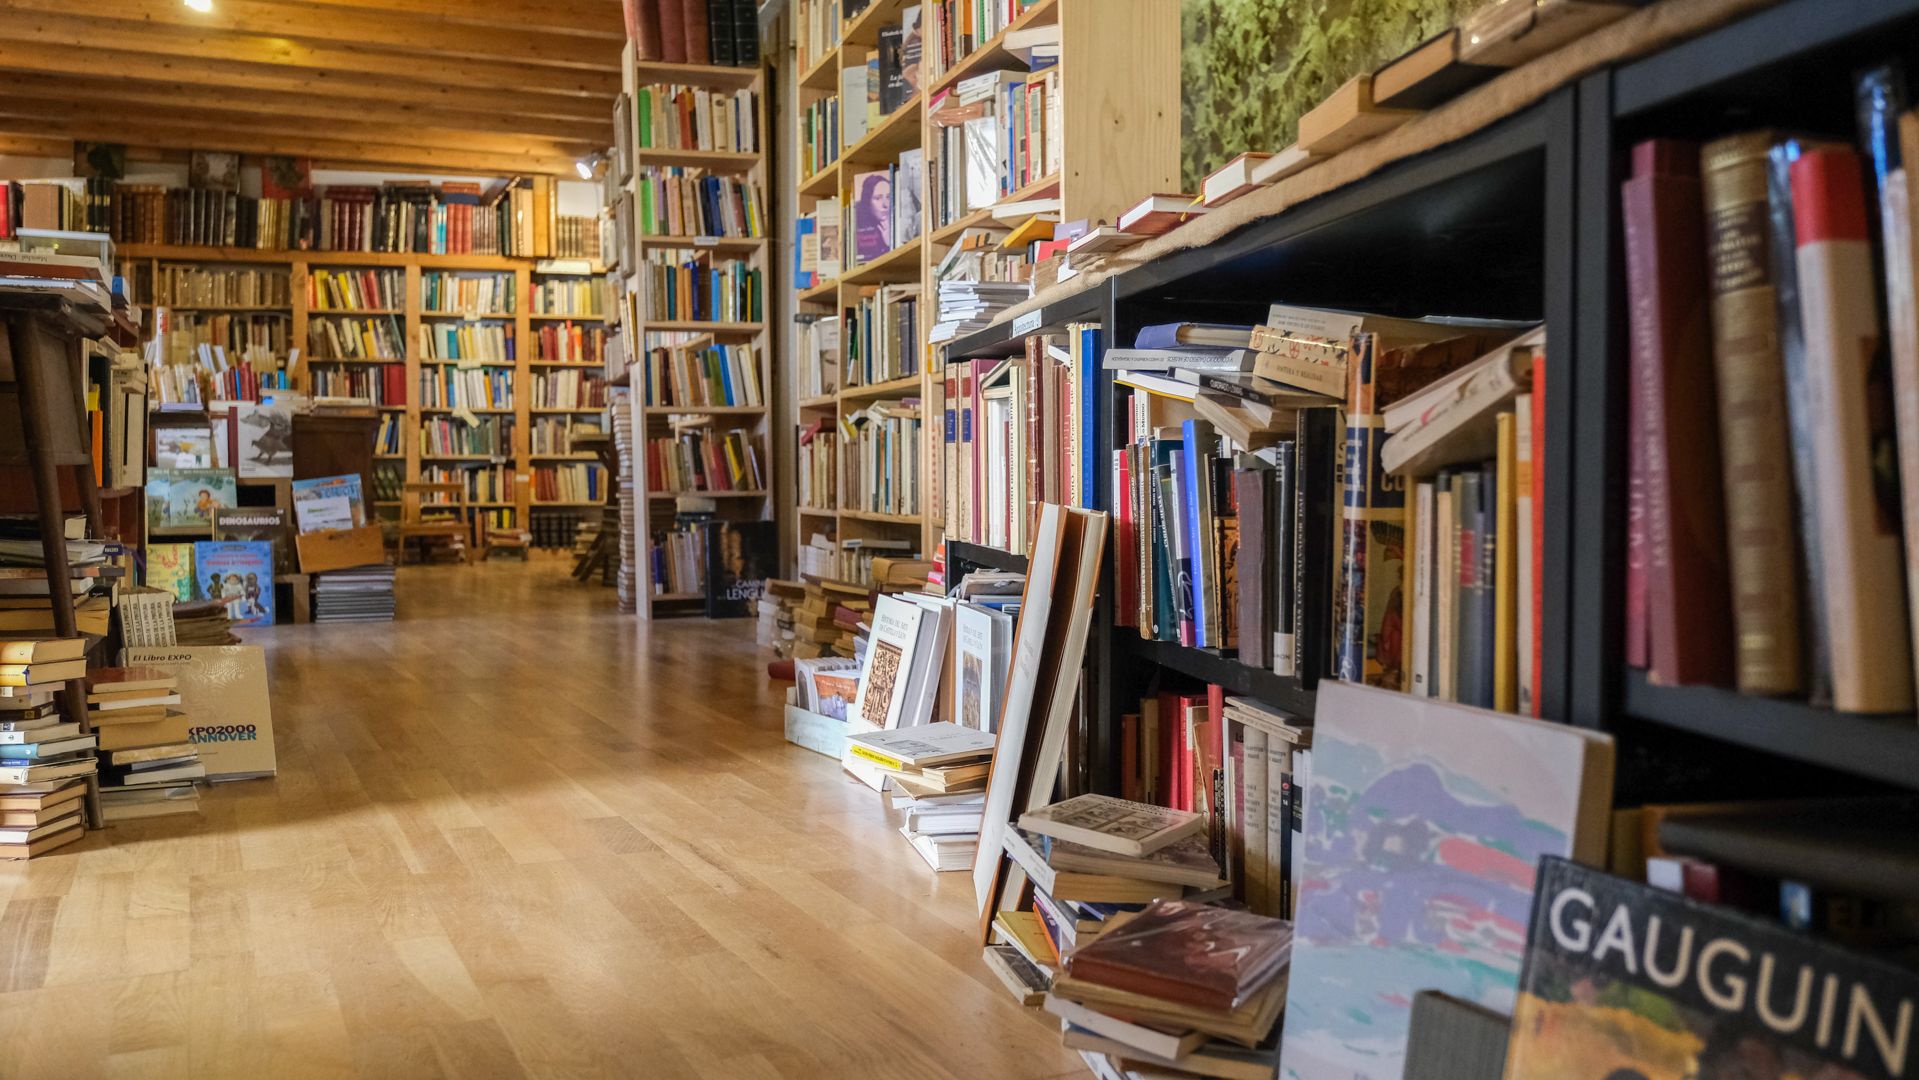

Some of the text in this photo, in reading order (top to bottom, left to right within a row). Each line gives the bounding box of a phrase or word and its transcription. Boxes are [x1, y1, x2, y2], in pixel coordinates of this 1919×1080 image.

[219, 517, 281, 526] DINOSAURIOS
[736, 579, 764, 588] CAMIN
[726, 588, 765, 600] LENGU
[143, 654, 165, 662] Libro
[188, 724, 257, 736] XPO2000
[188, 733, 257, 744] ANNOVER
[1550, 887, 1913, 1077] GAUGUIN
